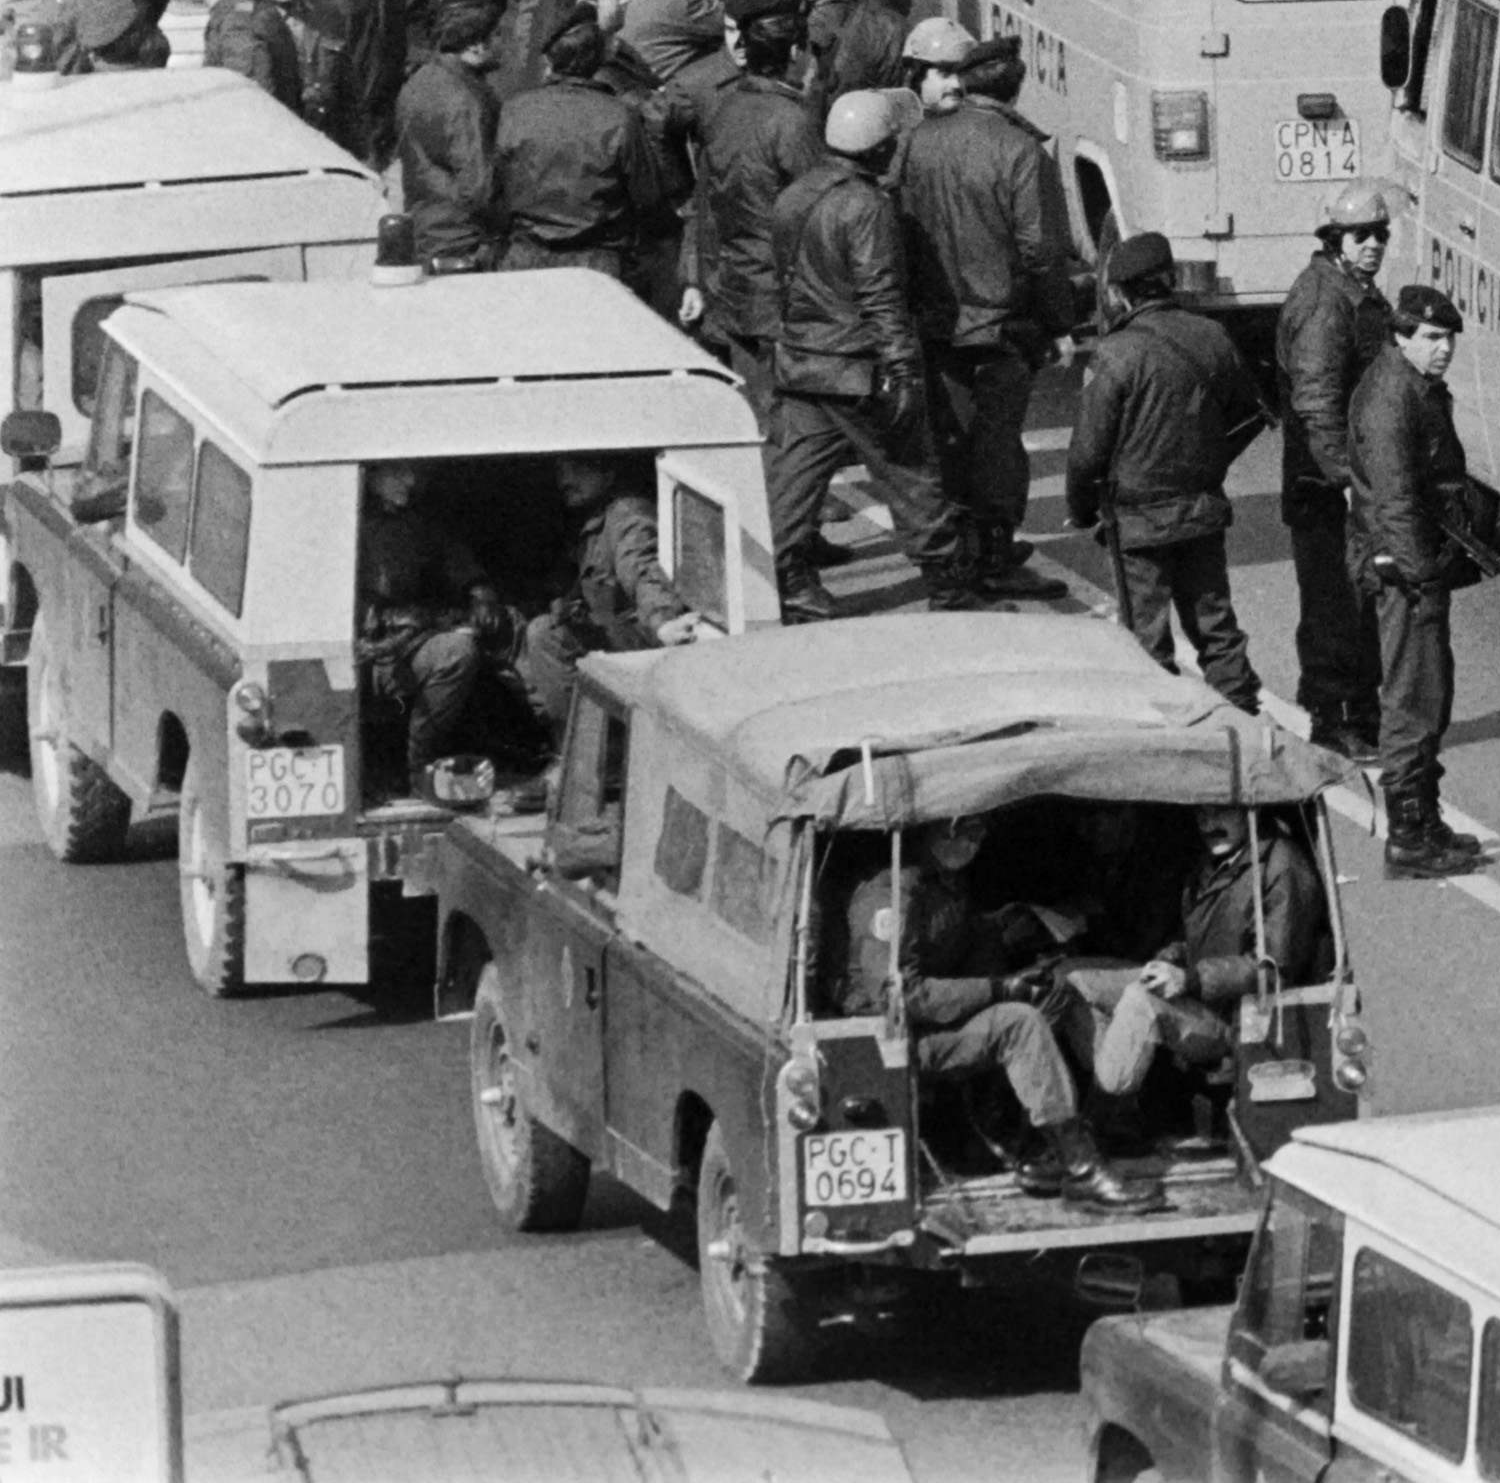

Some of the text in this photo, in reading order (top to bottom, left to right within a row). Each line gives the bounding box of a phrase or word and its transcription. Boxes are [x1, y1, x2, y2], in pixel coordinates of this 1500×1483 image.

[1278, 150, 1356, 177] 0814
[250, 781, 338, 815] 3070
[815, 1167, 897, 1202] 0694
[29, 1425, 69, 1462] IR
